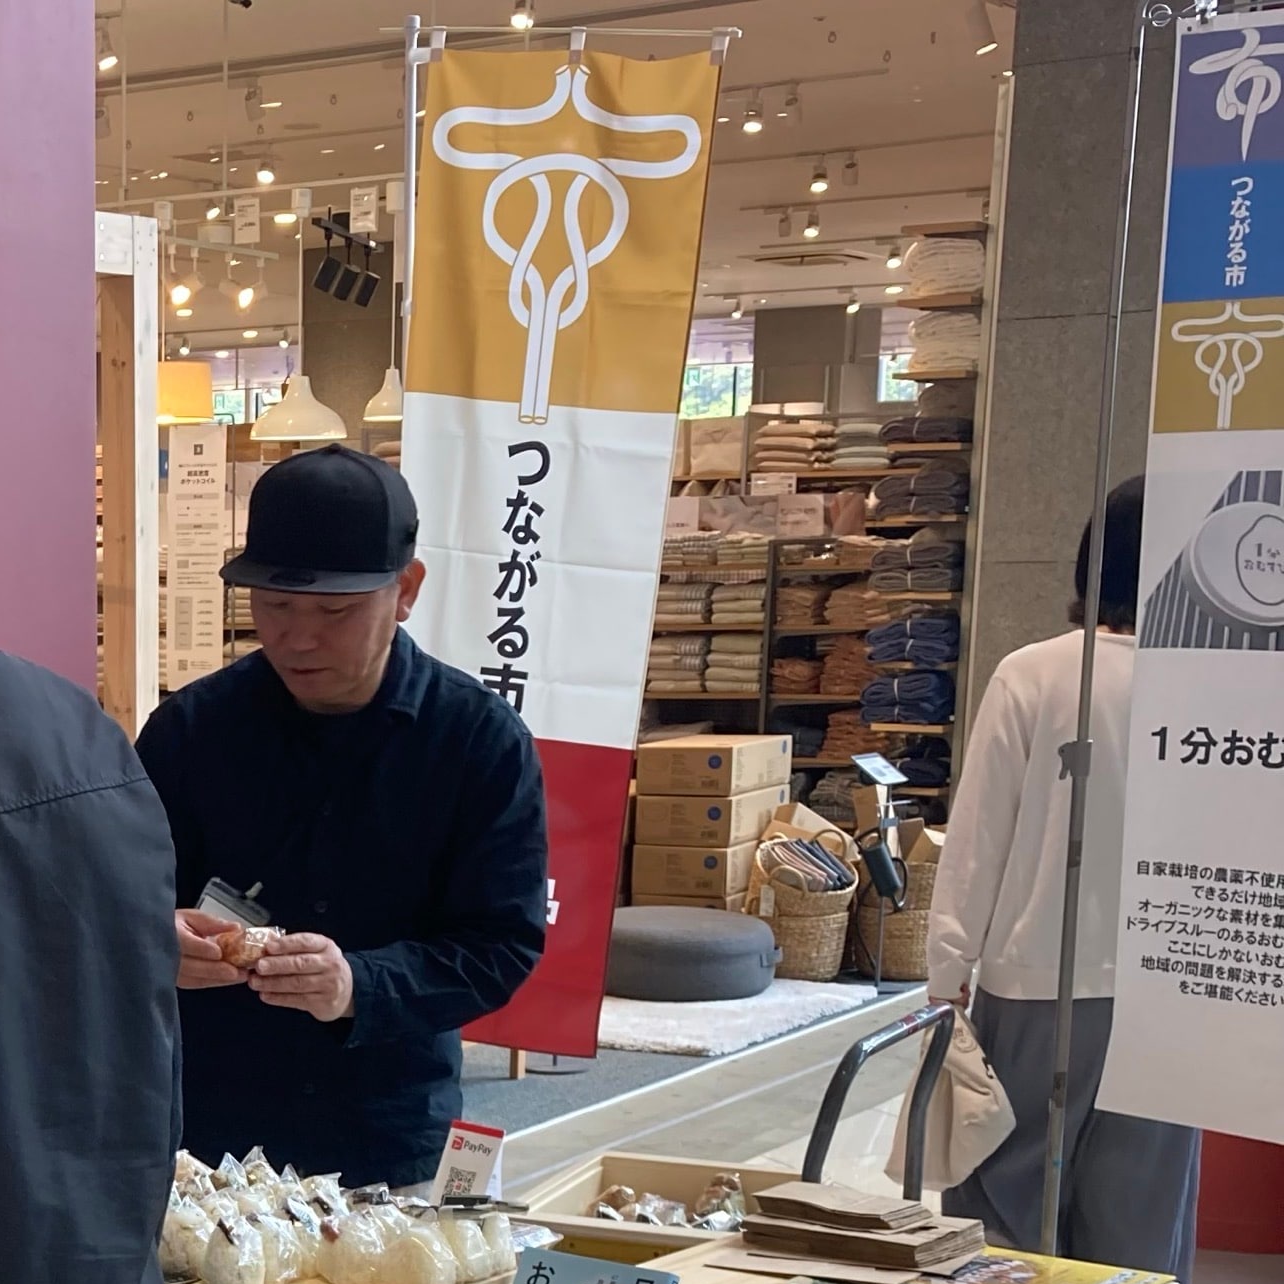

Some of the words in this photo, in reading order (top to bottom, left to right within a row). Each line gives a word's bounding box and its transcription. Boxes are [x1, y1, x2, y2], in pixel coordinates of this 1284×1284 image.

[1224, 176, 1254, 287] つながる市
[480, 440, 551, 714] つながる市
[1150, 725, 1284, 770] 1分おむ
[1136, 859, 1284, 890] 自家栽培の農薬不使用
[1191, 884, 1284, 910] できるだけ地域
[1138, 898, 1284, 930] オーガニックな素材を集
[1127, 915, 1284, 949] ドライブスルーのあるおむ
[1167, 939, 1284, 969] ここにしかないおむ
[1140, 954, 1284, 988] 地域の問題を解決する
[462, 1140, 493, 1157] PayPay
